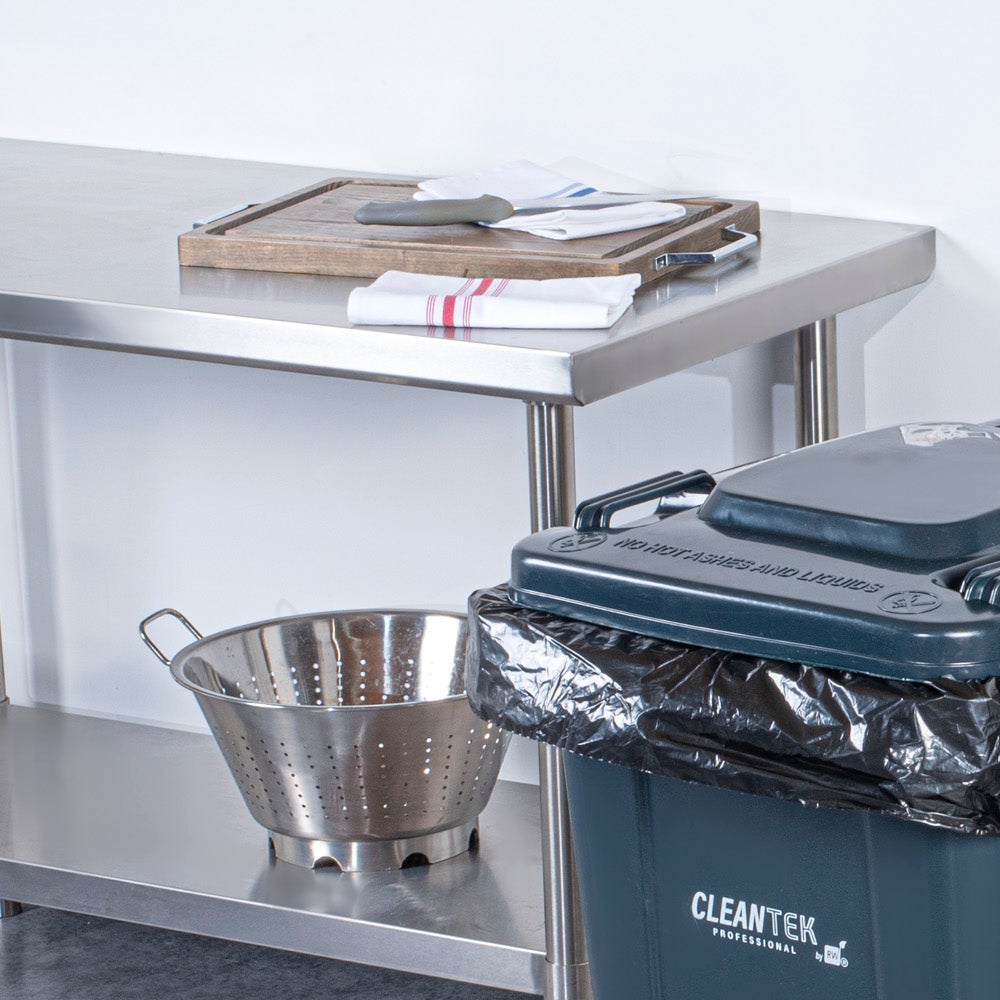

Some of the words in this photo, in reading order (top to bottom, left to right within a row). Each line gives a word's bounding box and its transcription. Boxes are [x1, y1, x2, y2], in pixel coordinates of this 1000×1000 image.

[613, 538, 648, 550] NO
[643, 544, 692, 558] HOT
[683, 551, 755, 572] ASHES
[750, 564, 799, 578] AND
[796, 571, 885, 593] LIQUIDS
[691, 891, 818, 945] CLEANTEK
[712, 927, 797, 954] PROFESSIONAL
[815, 951, 823, 962] by
